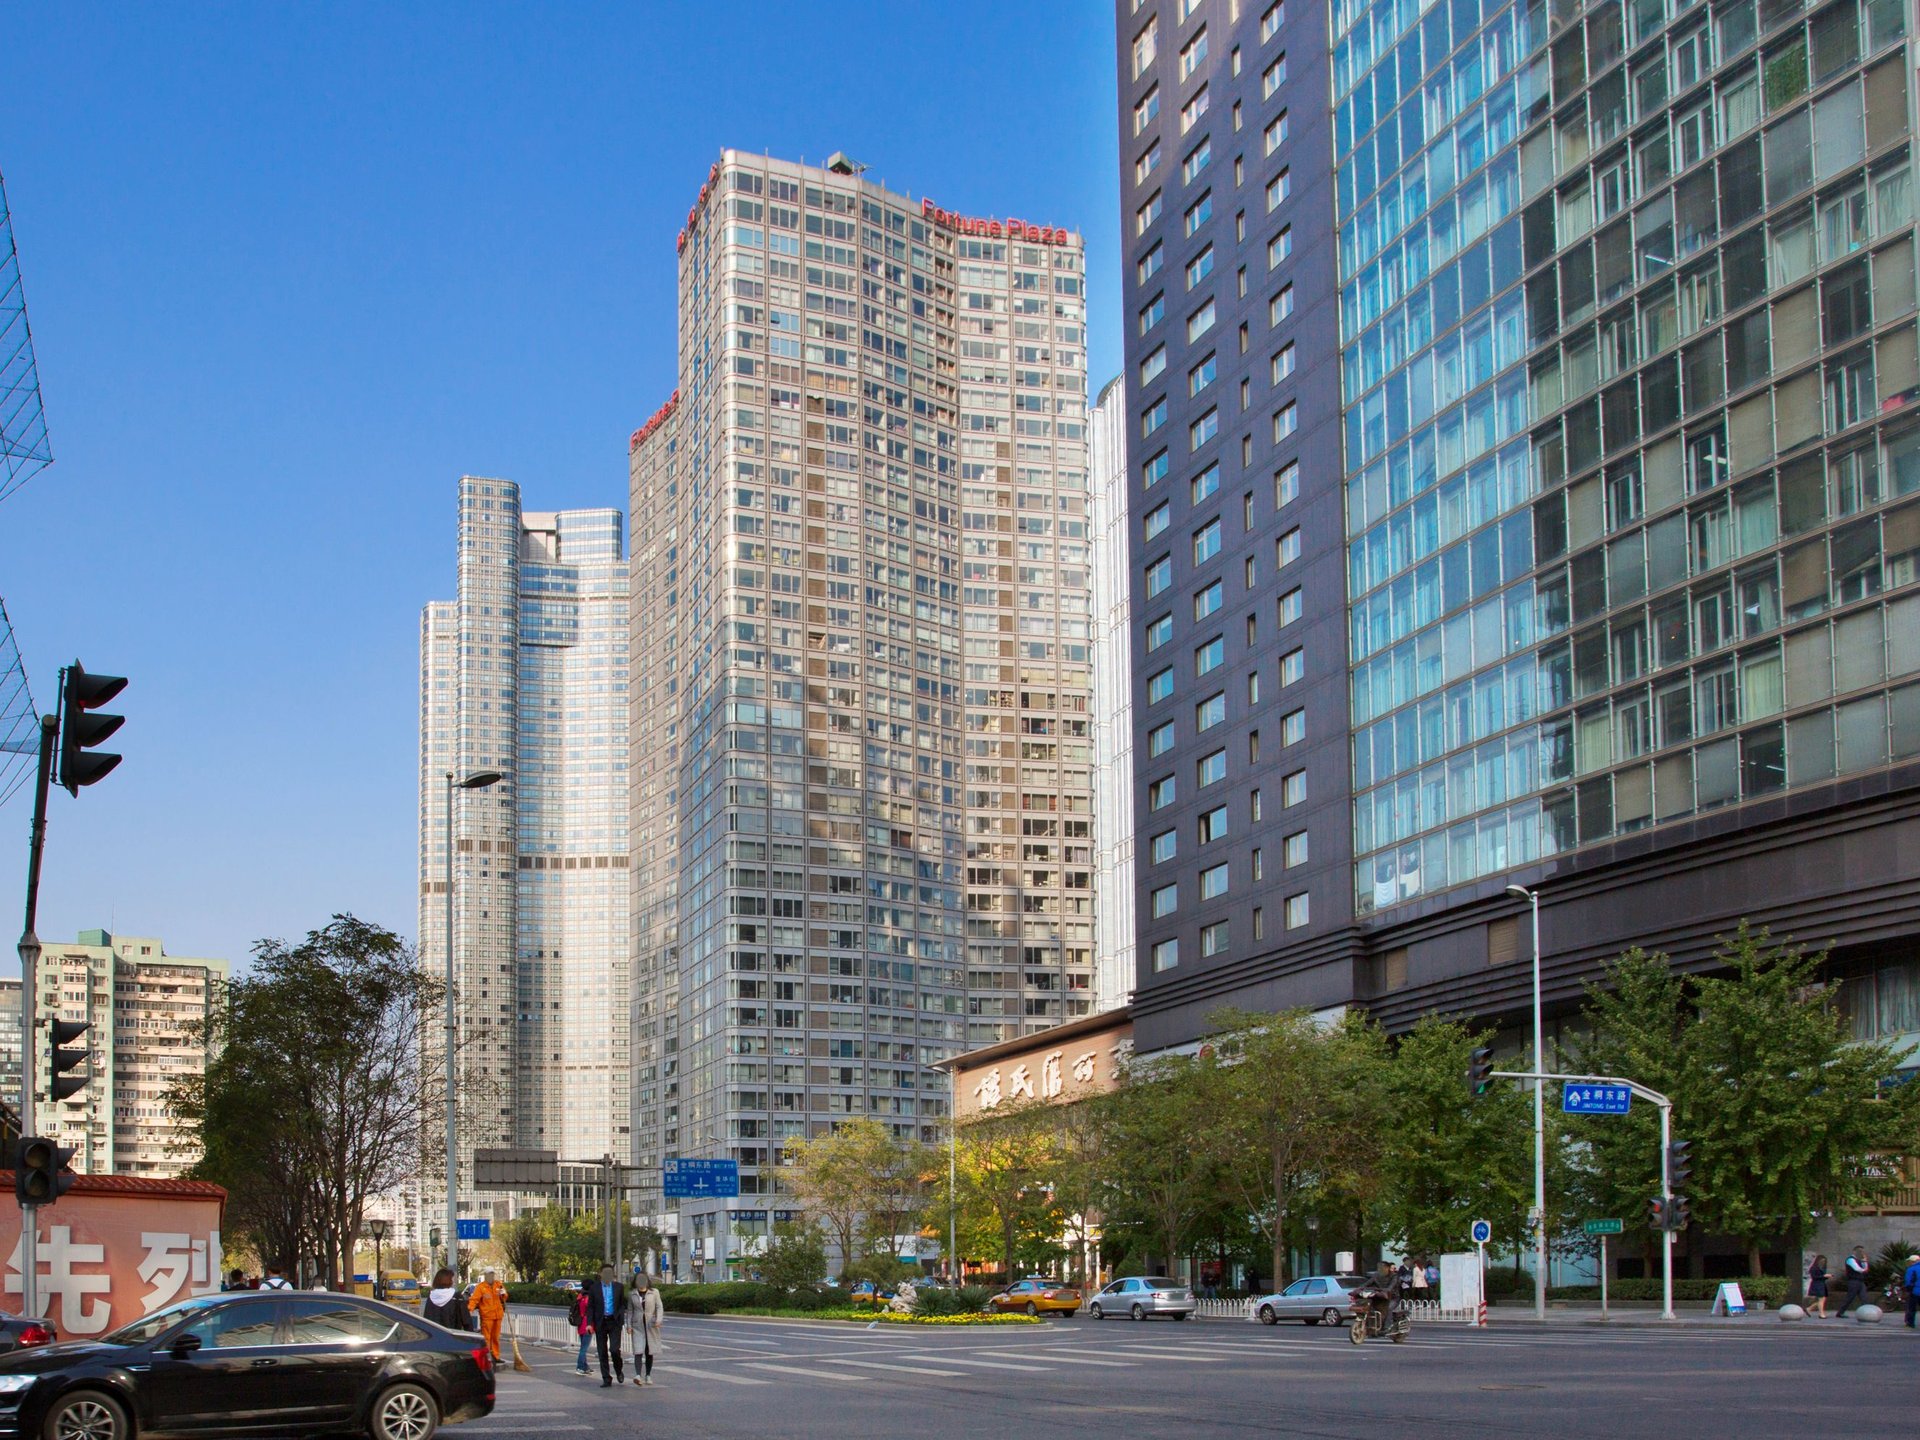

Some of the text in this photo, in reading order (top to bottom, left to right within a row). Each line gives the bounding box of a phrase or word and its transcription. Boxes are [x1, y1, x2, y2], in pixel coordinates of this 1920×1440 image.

[921, 196, 1068, 243] Fortune Plaza
[1582, 1089, 1626, 1101] 金桐东路
